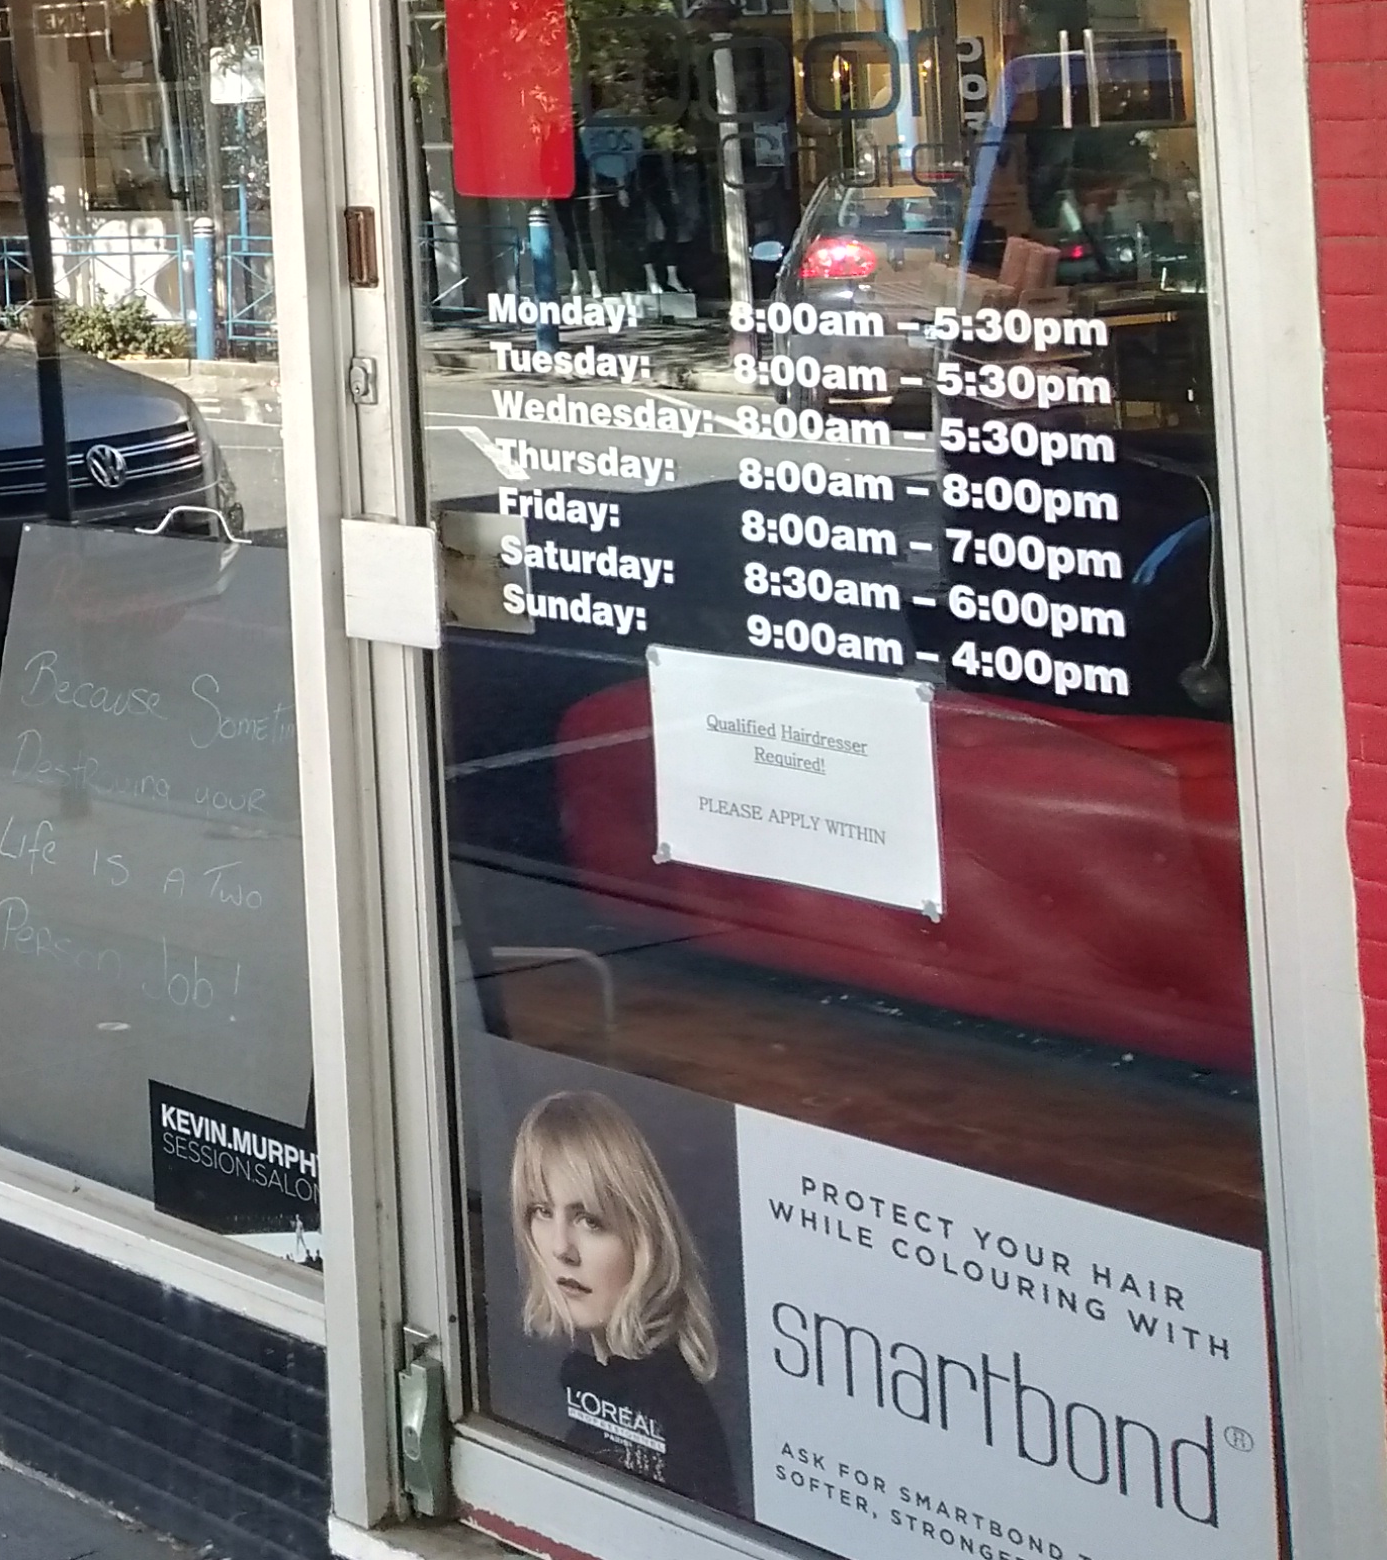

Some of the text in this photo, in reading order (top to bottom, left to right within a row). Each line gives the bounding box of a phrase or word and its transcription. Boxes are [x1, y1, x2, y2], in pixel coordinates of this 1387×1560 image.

[488, 293, 638, 333] Monday:
[729, 301, 885, 337] 8:00am
[933, 306, 1109, 351] 5:30pm
[489, 342, 650, 384] Tuesday:
[732, 353, 888, 392] 8:00am
[936, 362, 1112, 408] 5:30pm
[492, 389, 714, 438] Wednesday:
[735, 405, 891, 446] 8:00am
[939, 417, 1116, 466] 5:30pm
[494, 438, 675, 487] Thursday:
[738, 457, 894, 501] 8:00am
[942, 473, 1119, 524] 8:00pm
[498, 486, 620, 532] Friday:
[741, 509, 898, 556] 8:00am
[945, 528, 1123, 581] 7:00pm
[500, 534, 675, 588] Saturday:
[744, 562, 901, 611] 8:30am
[948, 584, 1126, 639] 6:00pm
[503, 583, 647, 635] Sunday:
[746, 614, 904, 666] 9:00am
[951, 641, 1129, 697] 4:00pm
[706, 713, 868, 756] Qualified Hairdresser
[754, 745, 827, 774] Required!
[698, 796, 887, 846] PLEASE APPLY WITHIN
[768, 1197, 1231, 1361] WHILE COLOURING WITH
[800, 1175, 1185, 1311] PROTECT YOUR HAIR
[771, 1301, 1220, 1530] smartbond
[774, 1464, 880, 1520] SOFTER,
[780, 1442, 1065, 1560] ASK FOR SMARTBOND
